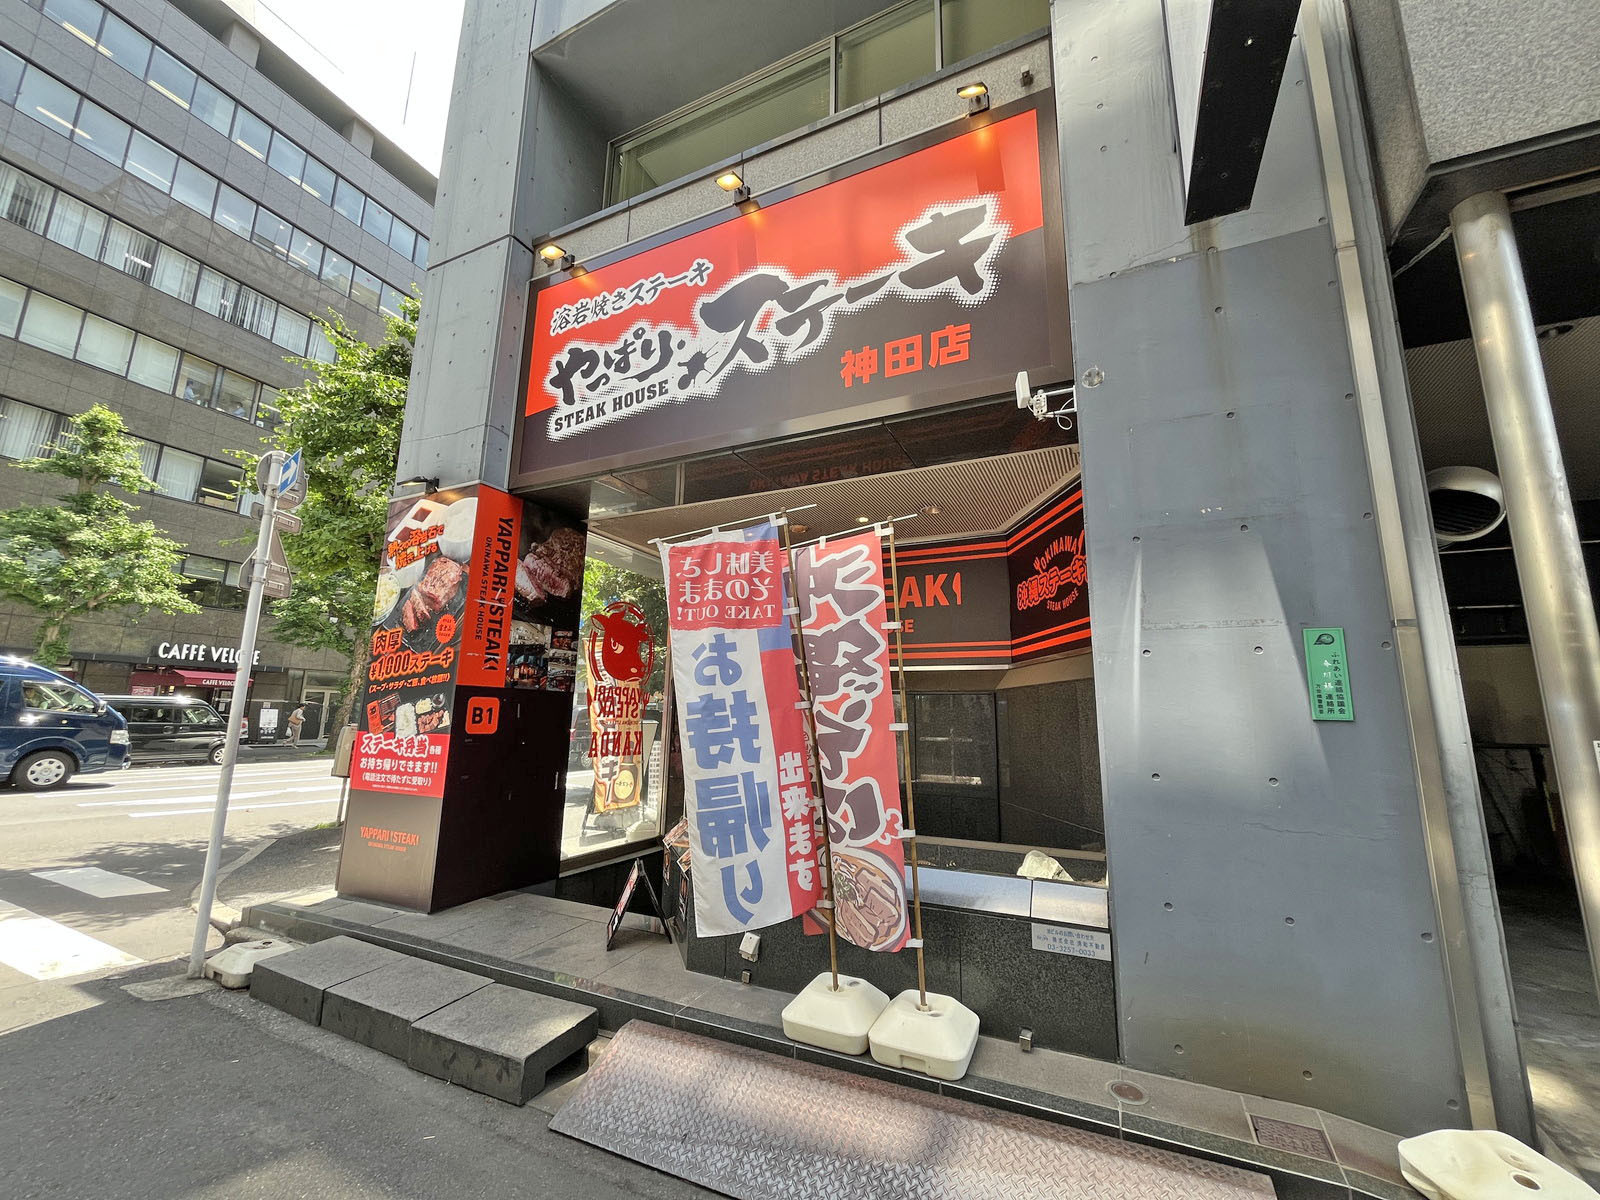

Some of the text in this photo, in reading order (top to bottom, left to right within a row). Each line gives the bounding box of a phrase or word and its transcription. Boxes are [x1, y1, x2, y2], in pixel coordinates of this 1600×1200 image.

[551, 260, 712, 334] 溶岩焼きステーキ
[839, 323, 972, 388] 神田店
[554, 379, 670, 433] STEAK HOUSE
[481, 536, 493, 577] OKINAWA
[491, 517, 514, 594] YAPPARI
[1040, 536, 1078, 569] OKINAWA
[1046, 599, 1062, 612] STEAK
[474, 611, 485, 641] HOUSE
[373, 629, 403, 655] 肉厚
[471, 706, 494, 725] B1
[360, 733, 429, 758] ステーキ弁当
[359, 758, 438, 774] お持ち帰りできます!!
[360, 826, 391, 842] YAPPARI
[778, 751, 815, 892] 出来ます
